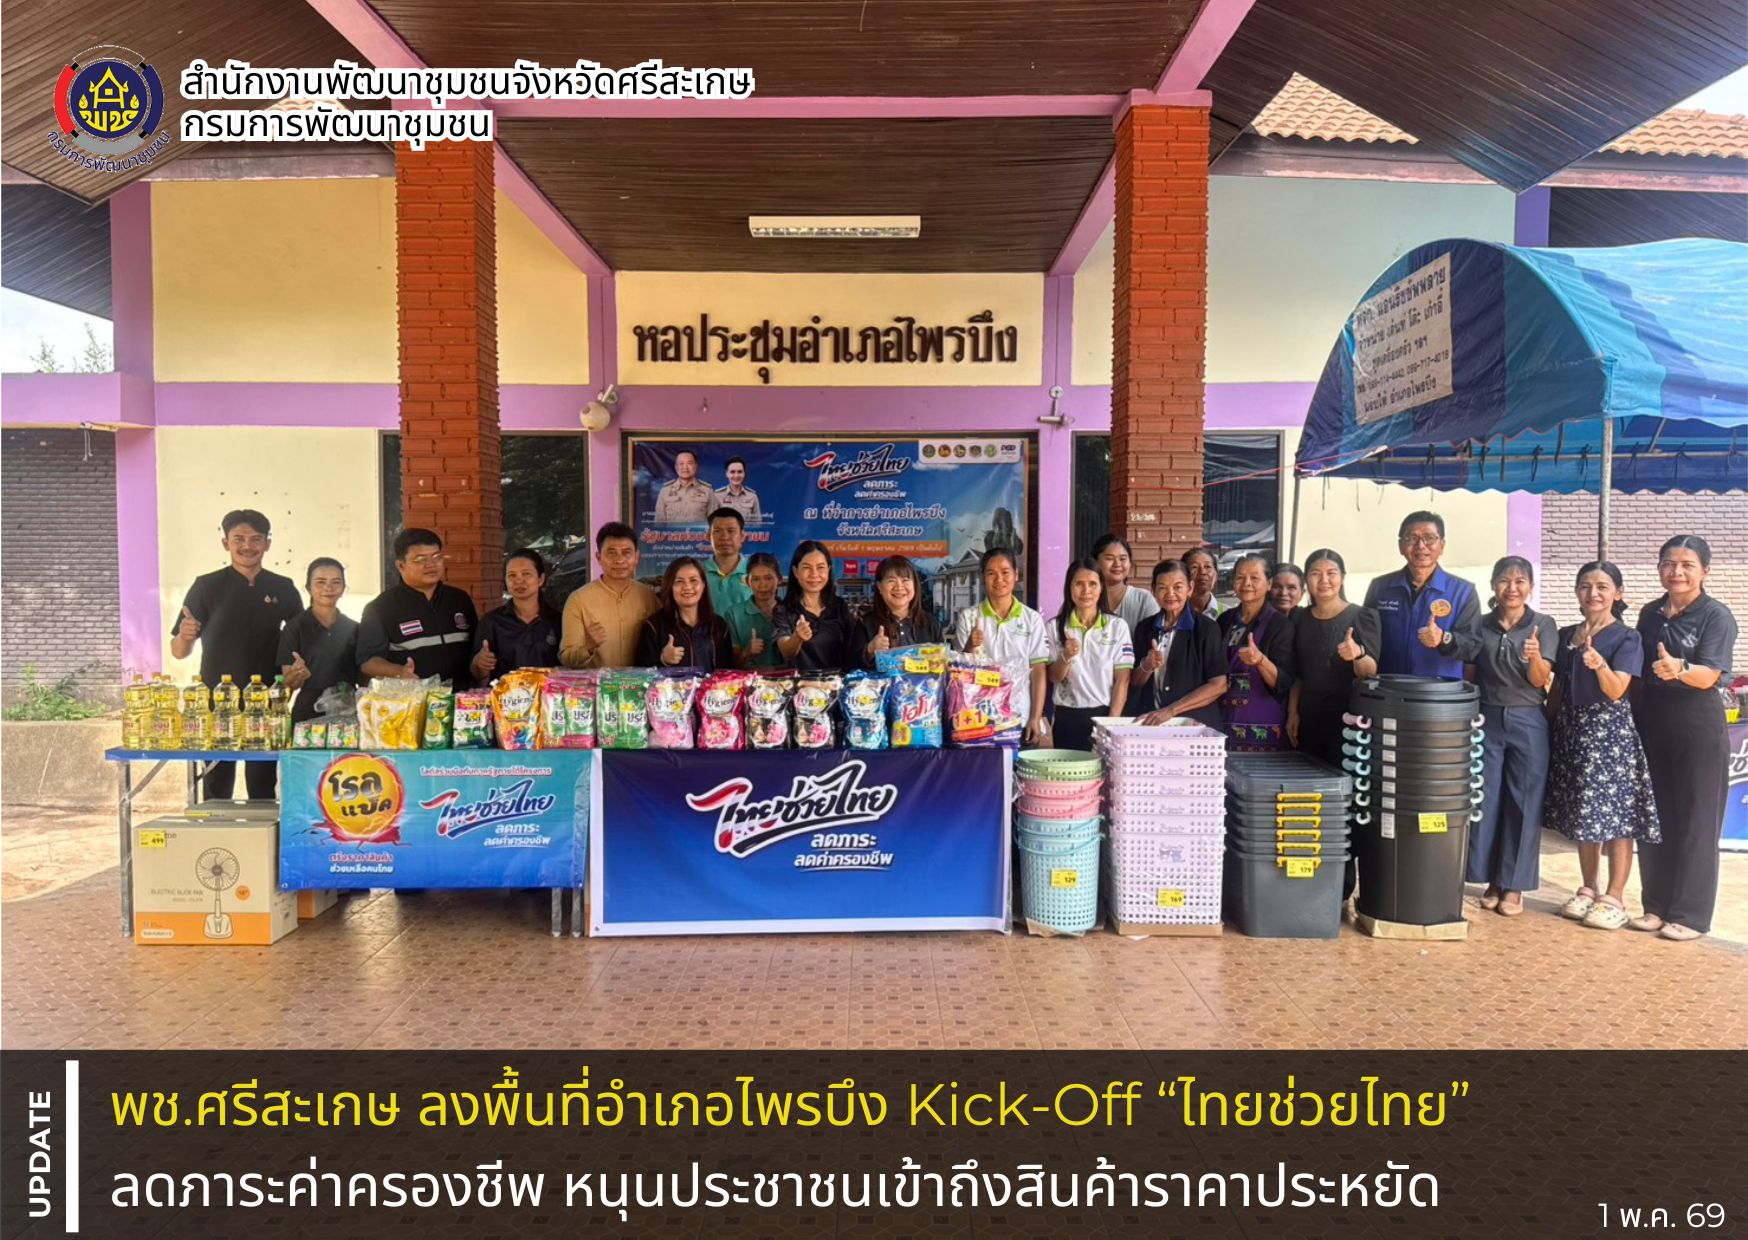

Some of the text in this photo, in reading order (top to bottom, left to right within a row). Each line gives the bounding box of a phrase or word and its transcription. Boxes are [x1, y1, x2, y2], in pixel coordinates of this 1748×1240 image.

[632, 309, 1019, 384] หอประชุมอำเภอไพรบึง
[804, 443, 911, 492] ไทยช่วยไทย
[863, 480, 898, 489] ลดภาระ
[804, 500, 948, 520] ณ ที่ว่าการอำเภอไพรบึง
[837, 522, 923, 537] จังหวัดศรีสะเกษ
[419, 779, 557, 838] ไทยช่วยไทย
[686, 759, 898, 858] ไทยช่วยไทย
[494, 824, 541, 836] ลดภาระ
[483, 835, 552, 846] ลดค่าครองชีพ
[810, 833, 877, 848] ลดภาระ
[794, 849, 894, 867] ลดค่าครองชีพ
[329, 863, 394, 873] ช่วยเหลือคนไทย
